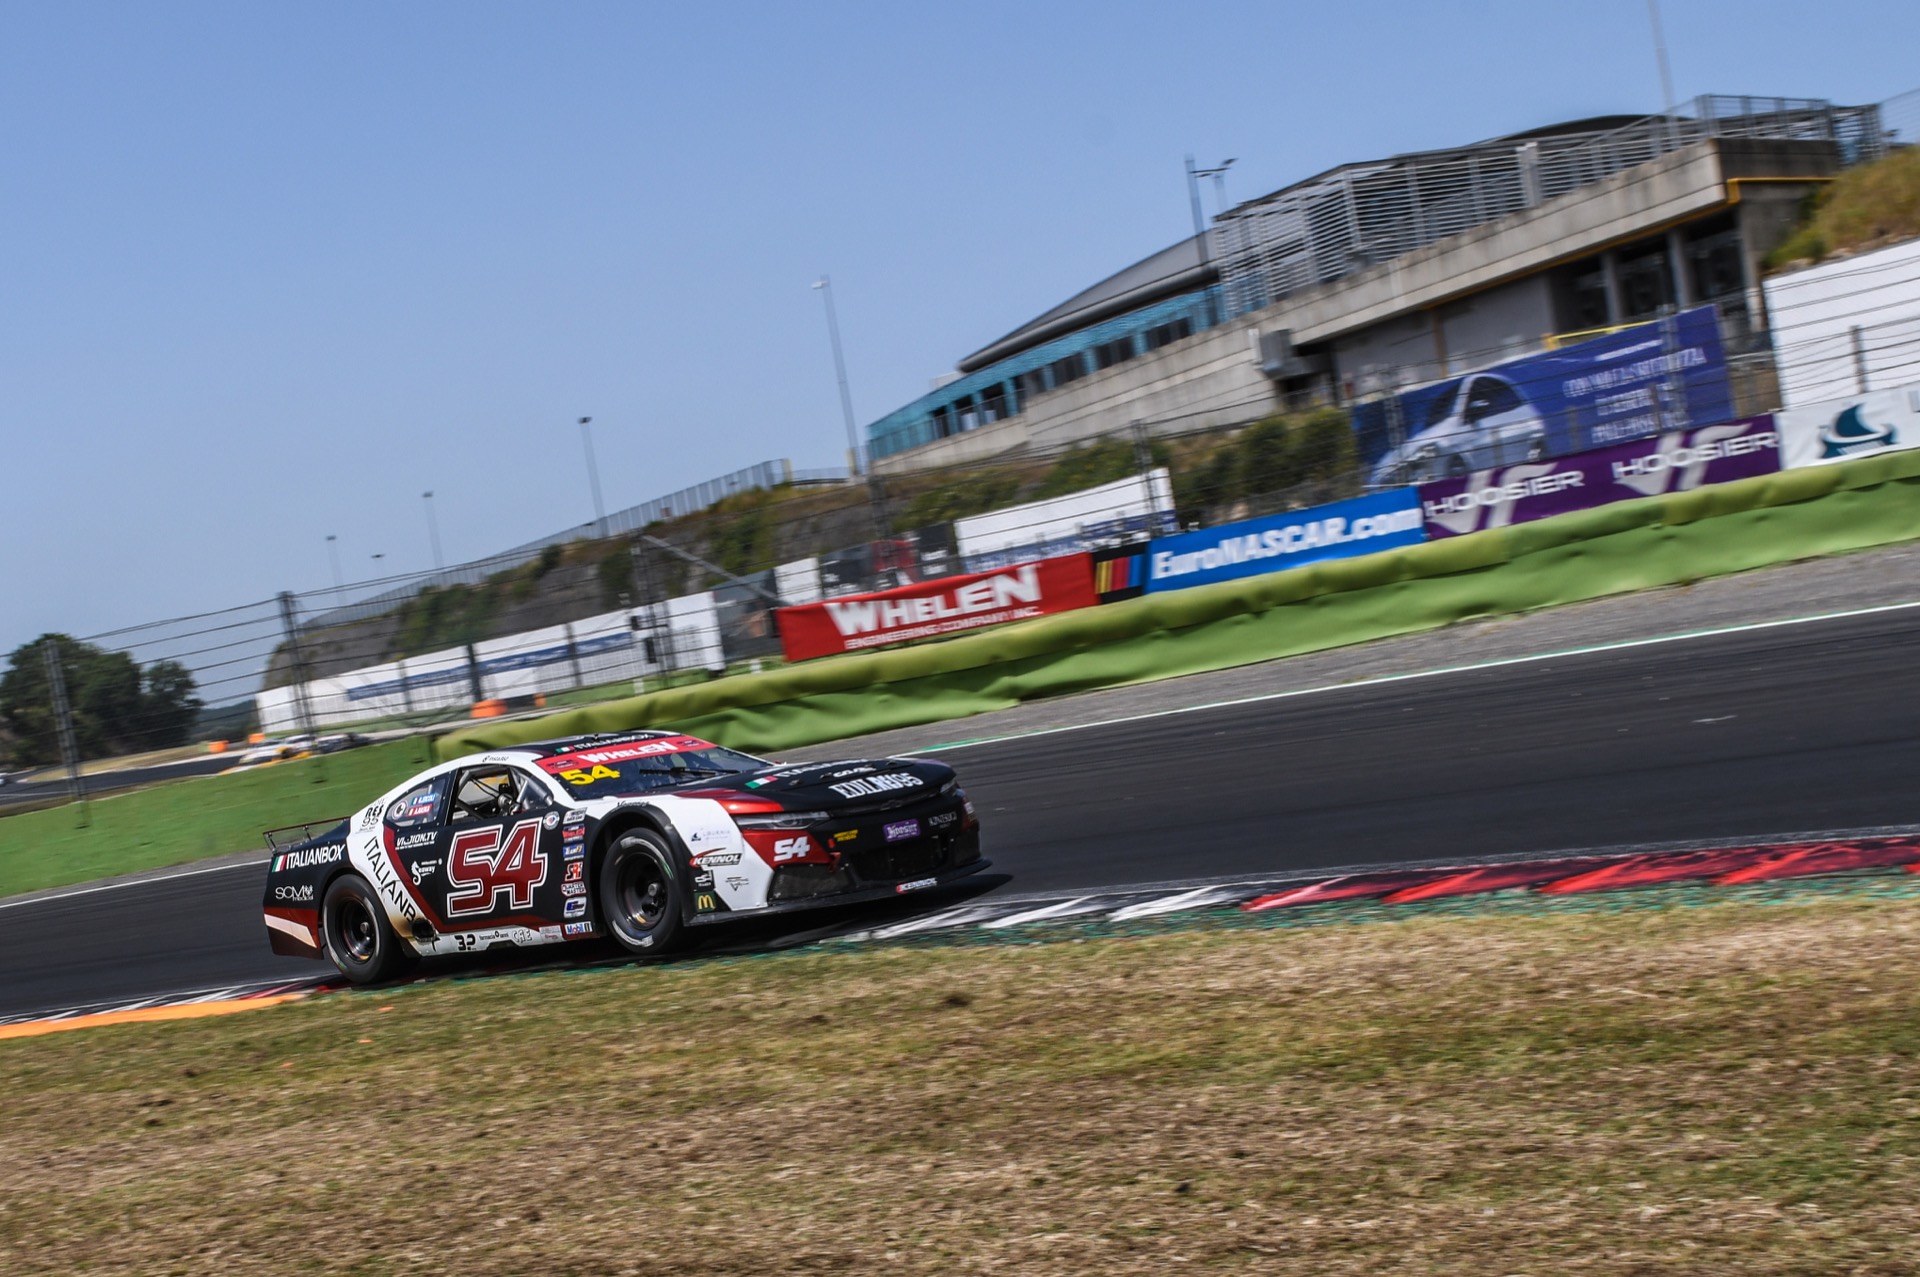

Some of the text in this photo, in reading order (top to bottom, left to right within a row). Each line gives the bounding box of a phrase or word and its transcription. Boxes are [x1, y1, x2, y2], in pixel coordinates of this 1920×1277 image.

[1613, 431, 1779, 479] HOOSIER
[1424, 471, 1584, 517] HOOSIER
[1152, 508, 1422, 580] EuroNASCAR.com
[824, 563, 1042, 636] WHELEN
[845, 624, 939, 649] ENGINEERING
[577, 741, 678, 763] WHELEN
[559, 764, 620, 786] 54
[286, 844, 345, 870] ITALIANBOX
[693, 854, 740, 866] KENNOL
[773, 836, 811, 862] 54
[364, 836, 425, 930] ITALIANB
[447, 817, 548, 918] 54
